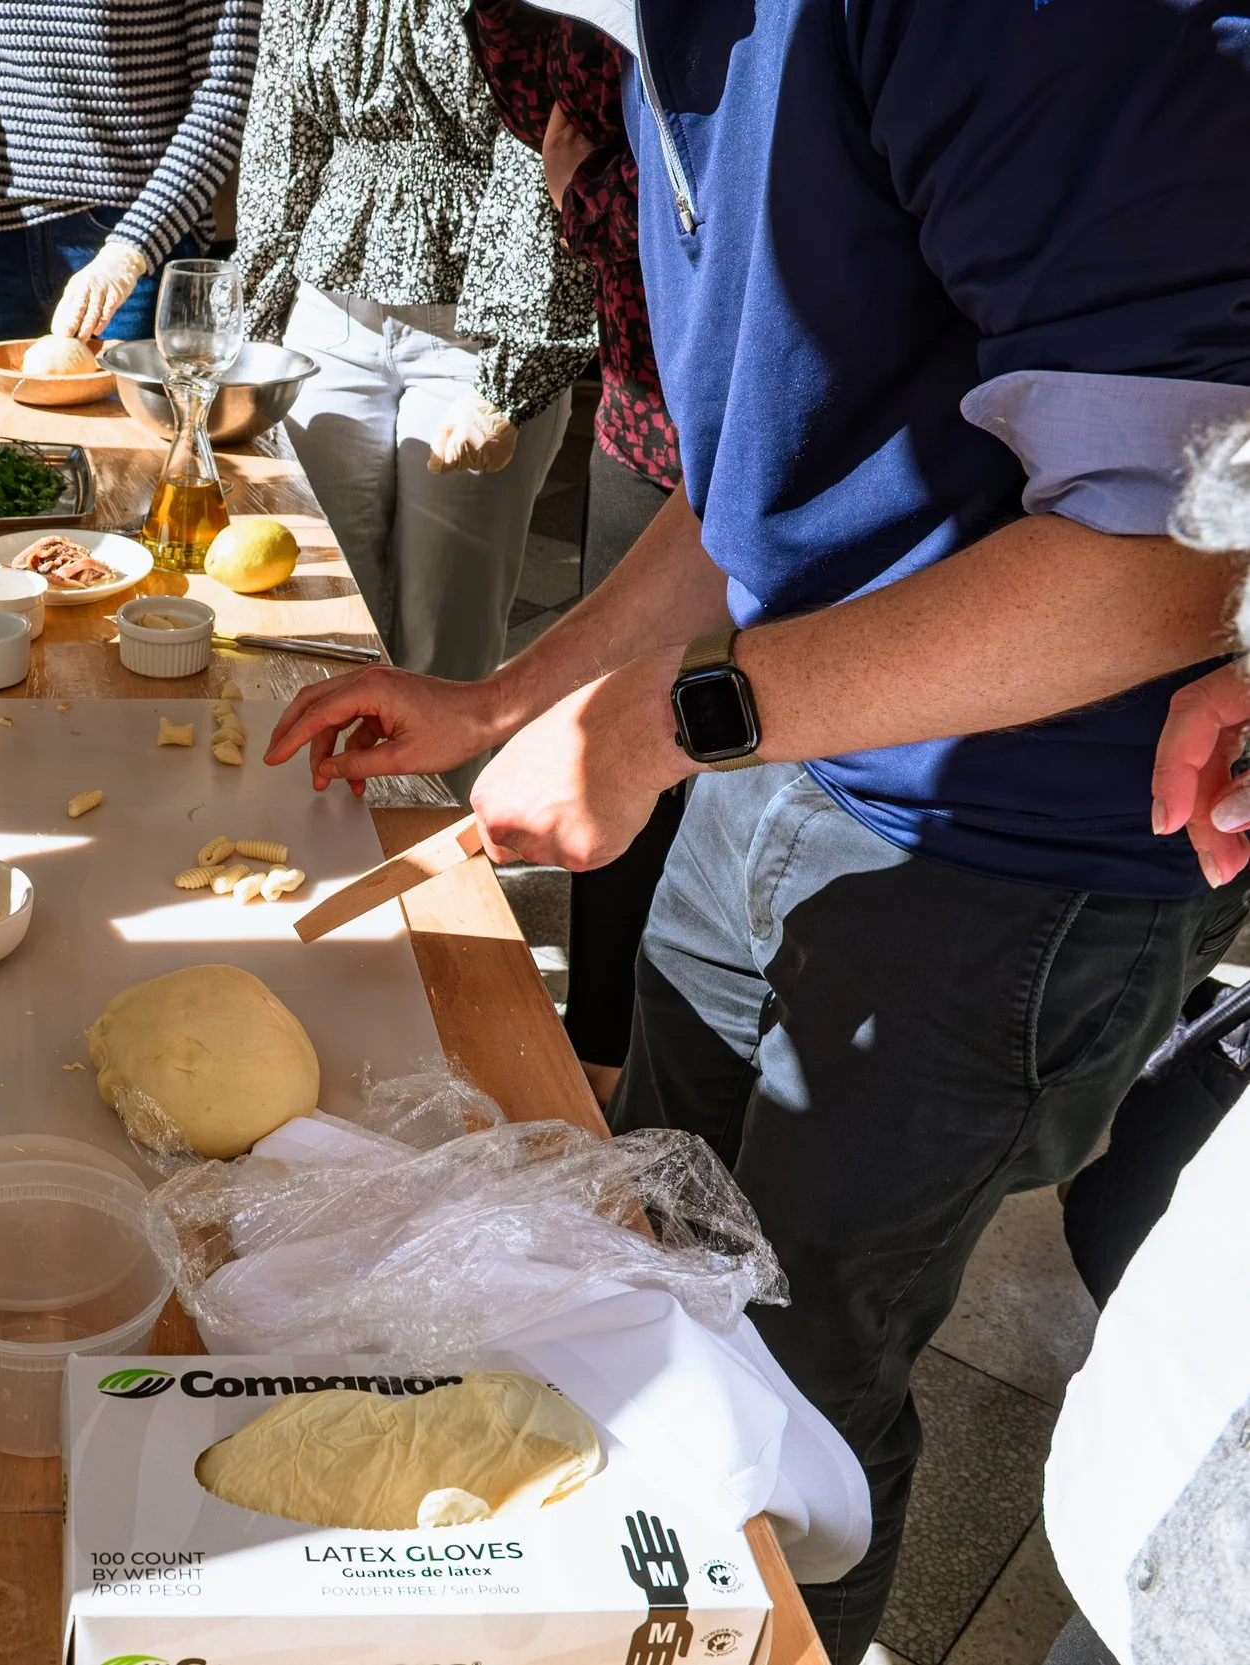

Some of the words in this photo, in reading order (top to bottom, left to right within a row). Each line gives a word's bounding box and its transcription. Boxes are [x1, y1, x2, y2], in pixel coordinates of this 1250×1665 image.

[91, 1552, 125, 1565] 100
[131, 1552, 206, 1565] COUNT
[304, 1546, 397, 1563] LATEX
[405, 1542, 524, 1562] GLOVES
[92, 1568, 118, 1580] BY
[123, 1568, 204, 1580] WEIGHT
[342, 1567, 416, 1578] Guantes
[421, 1566, 443, 1577] de
[448, 1565, 492, 1577] látex
[646, 1561, 679, 1587] M
[91, 1582, 142, 1597] /POR
[150, 1584, 202, 1596] PESO
[321, 1586, 393, 1597] POWDER
[398, 1585, 437, 1596] FREE
[450, 1585, 474, 1596] Sin
[478, 1584, 520, 1595] Polvo
[647, 1622, 677, 1644] M
